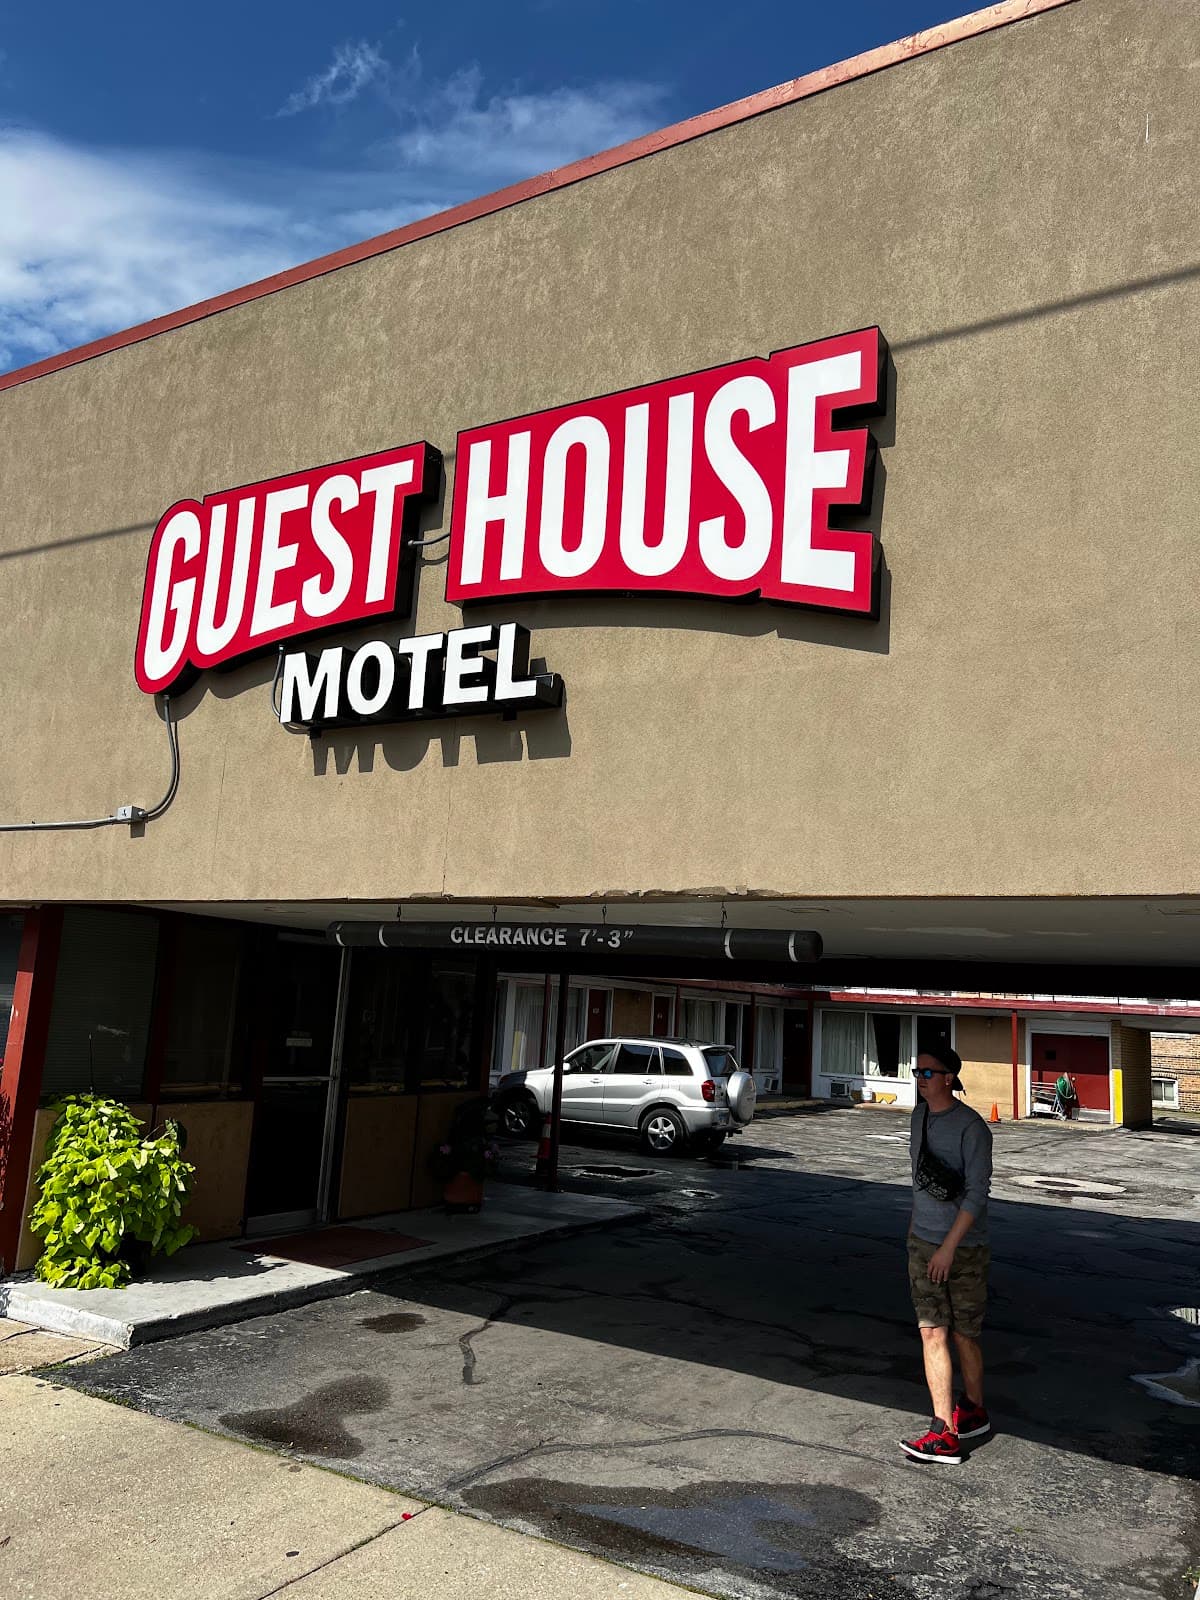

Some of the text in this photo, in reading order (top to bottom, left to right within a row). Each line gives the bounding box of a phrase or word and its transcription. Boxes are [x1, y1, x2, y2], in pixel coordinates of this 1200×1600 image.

[143, 350, 862, 681] GUEST HOUSE
[280, 622, 538, 724] MOTEL
[450, 926, 567, 947] CLEARANCE
